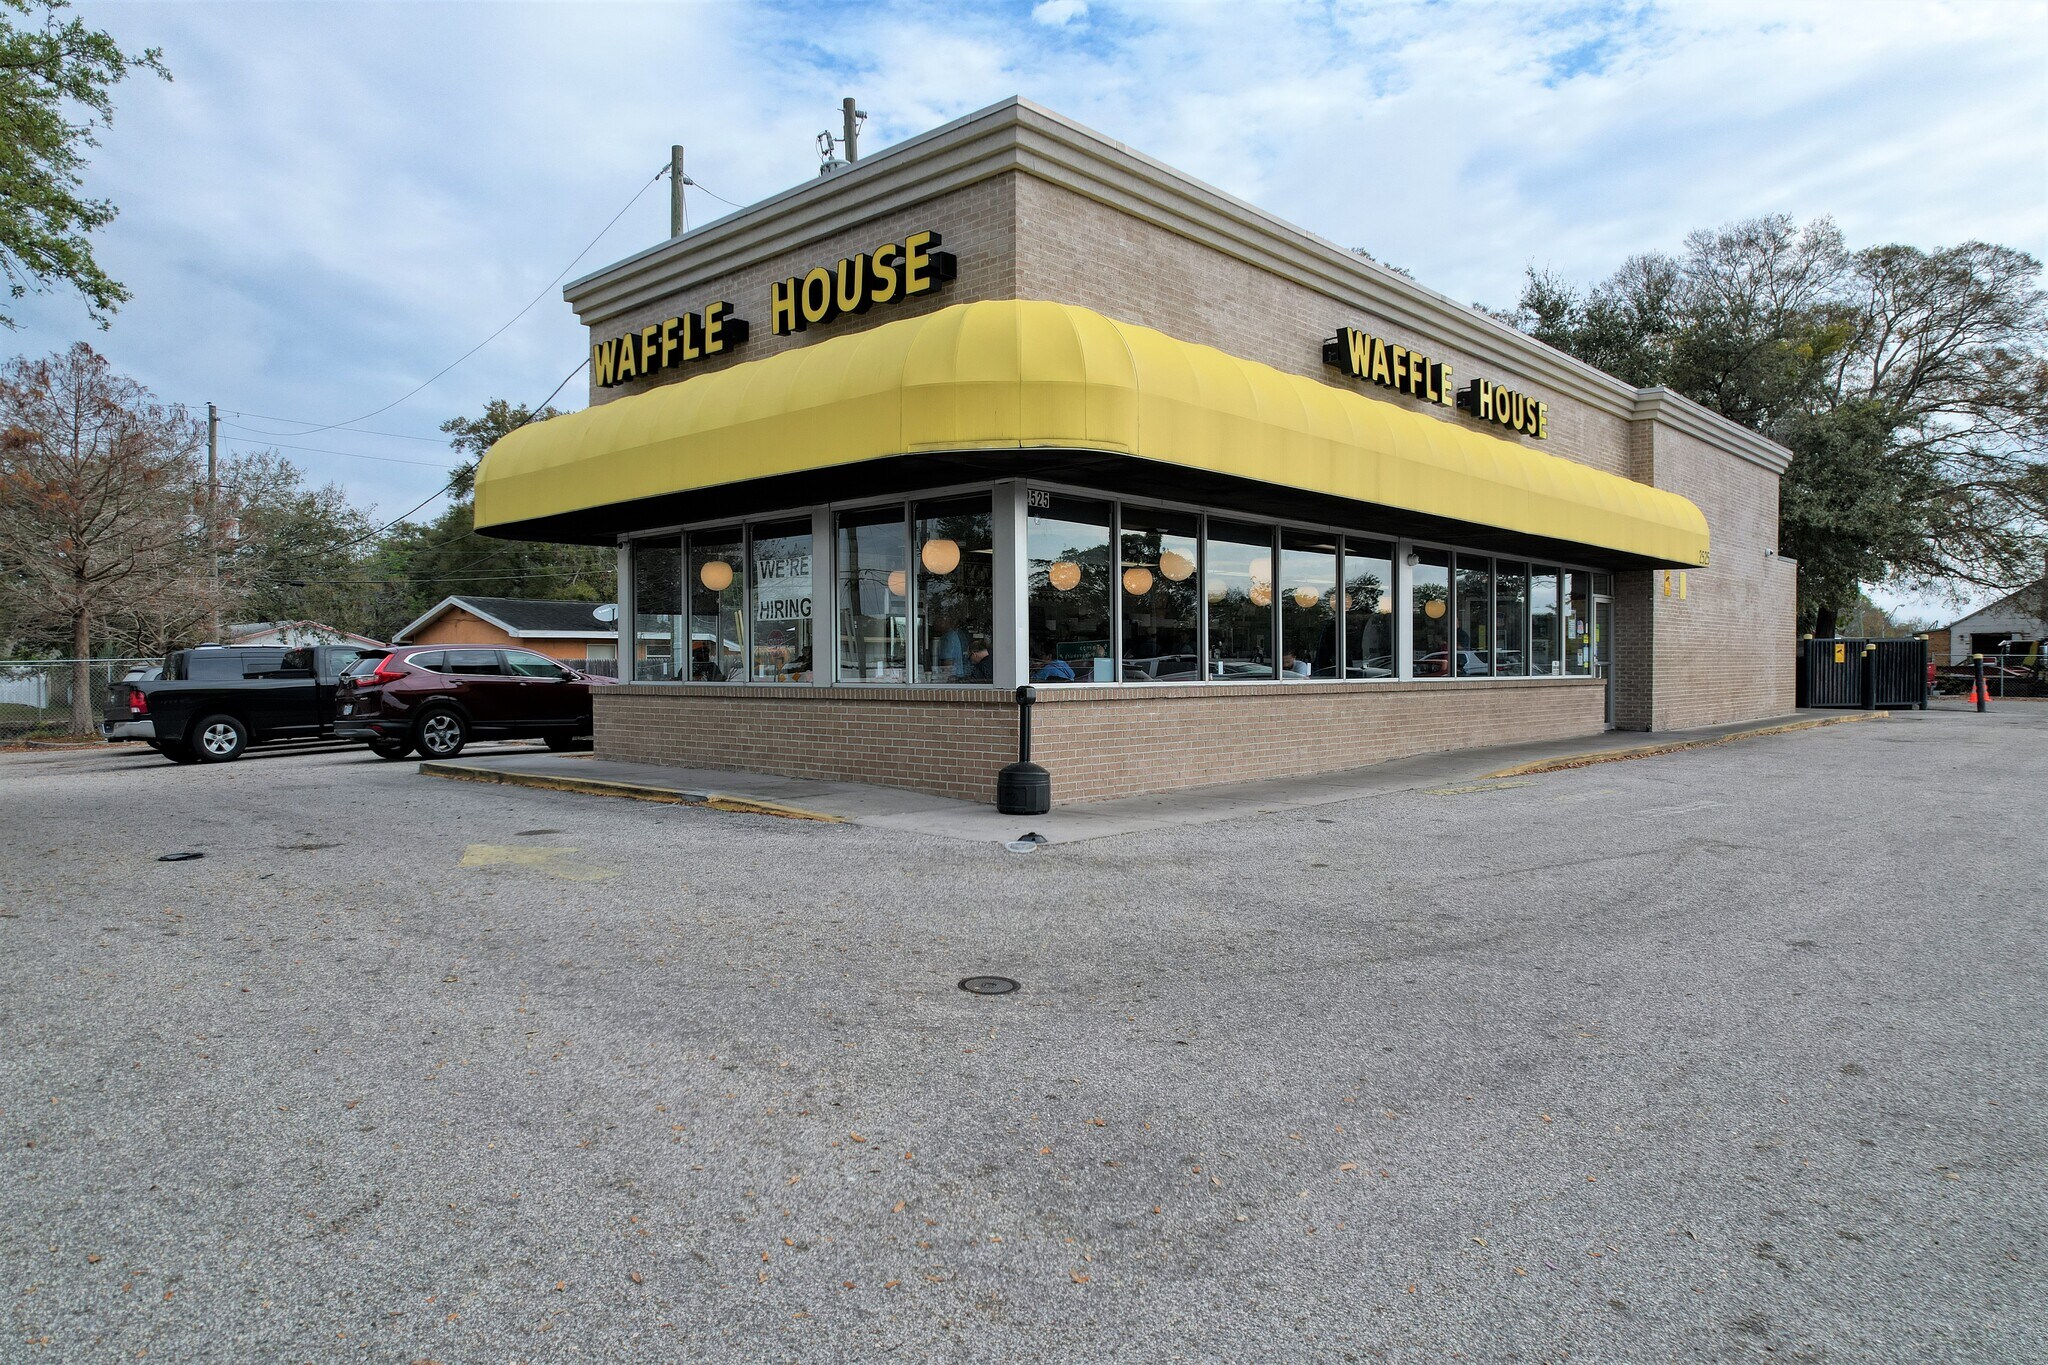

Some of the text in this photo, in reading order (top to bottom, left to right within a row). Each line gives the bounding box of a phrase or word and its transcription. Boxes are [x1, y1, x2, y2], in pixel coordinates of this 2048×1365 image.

[593, 230, 933, 388] WAFFLE HOUSE
[1345, 327, 1548, 440] WAFFLE HOUSE
[760, 556, 809, 579] WE'RE
[760, 597, 811, 620] HIRING
